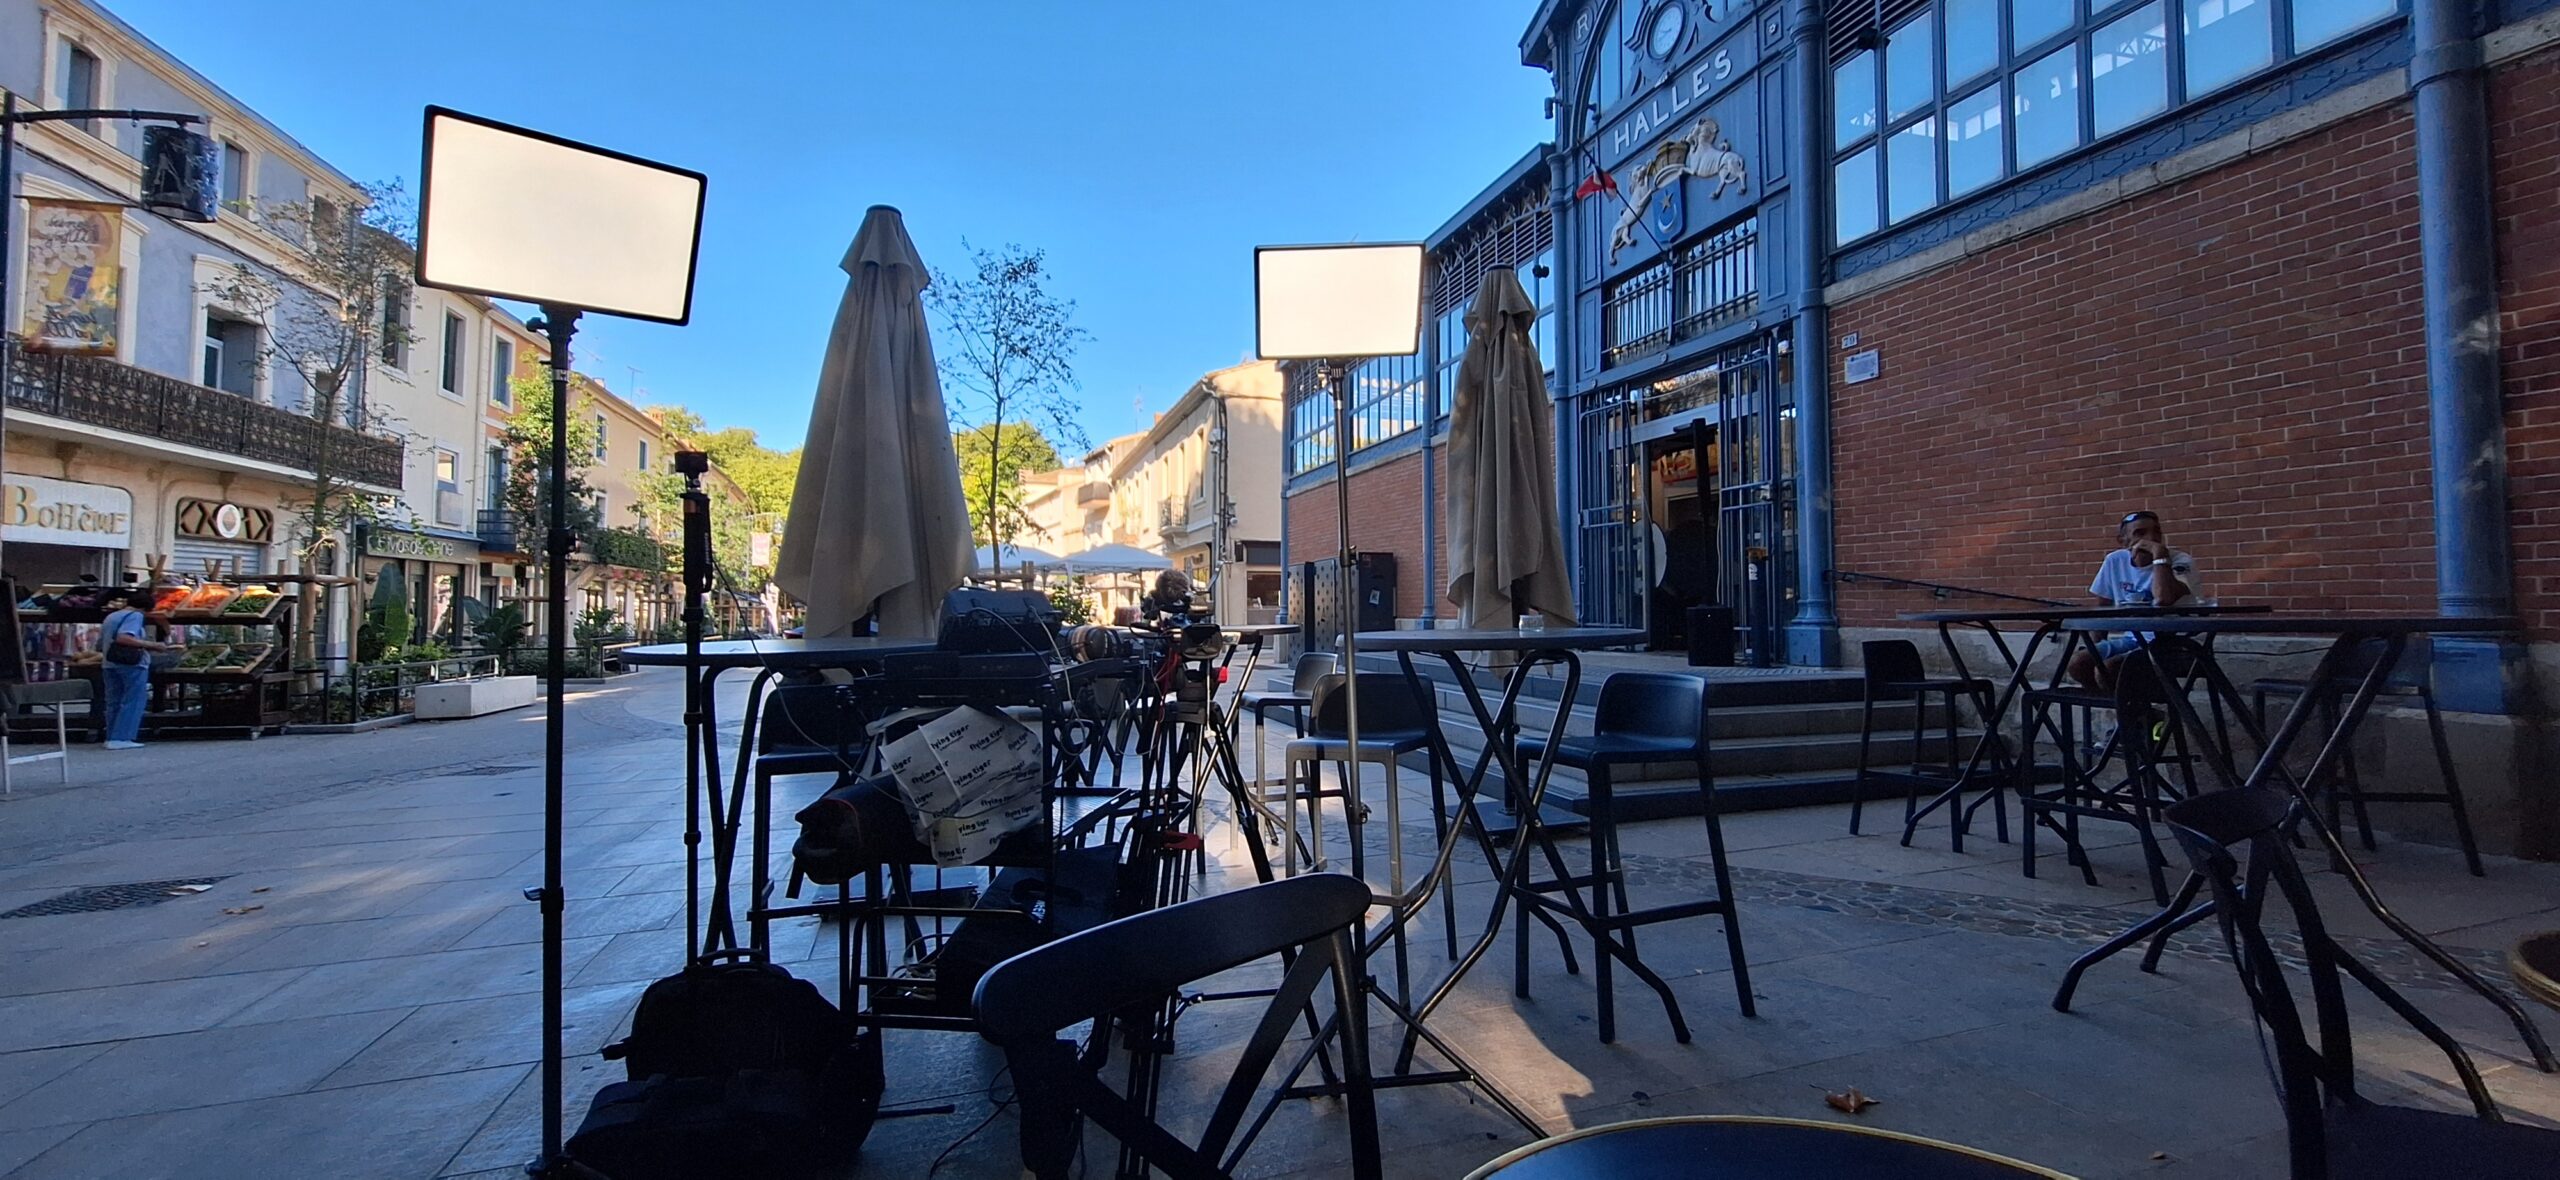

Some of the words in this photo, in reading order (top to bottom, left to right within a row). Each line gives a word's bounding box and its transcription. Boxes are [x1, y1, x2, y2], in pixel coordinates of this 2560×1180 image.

[1577, 13, 1589, 40] R
[1614, 49, 1732, 155] HALLES
[949, 724, 969, 738] tiger
[972, 759, 991, 774] tiger
